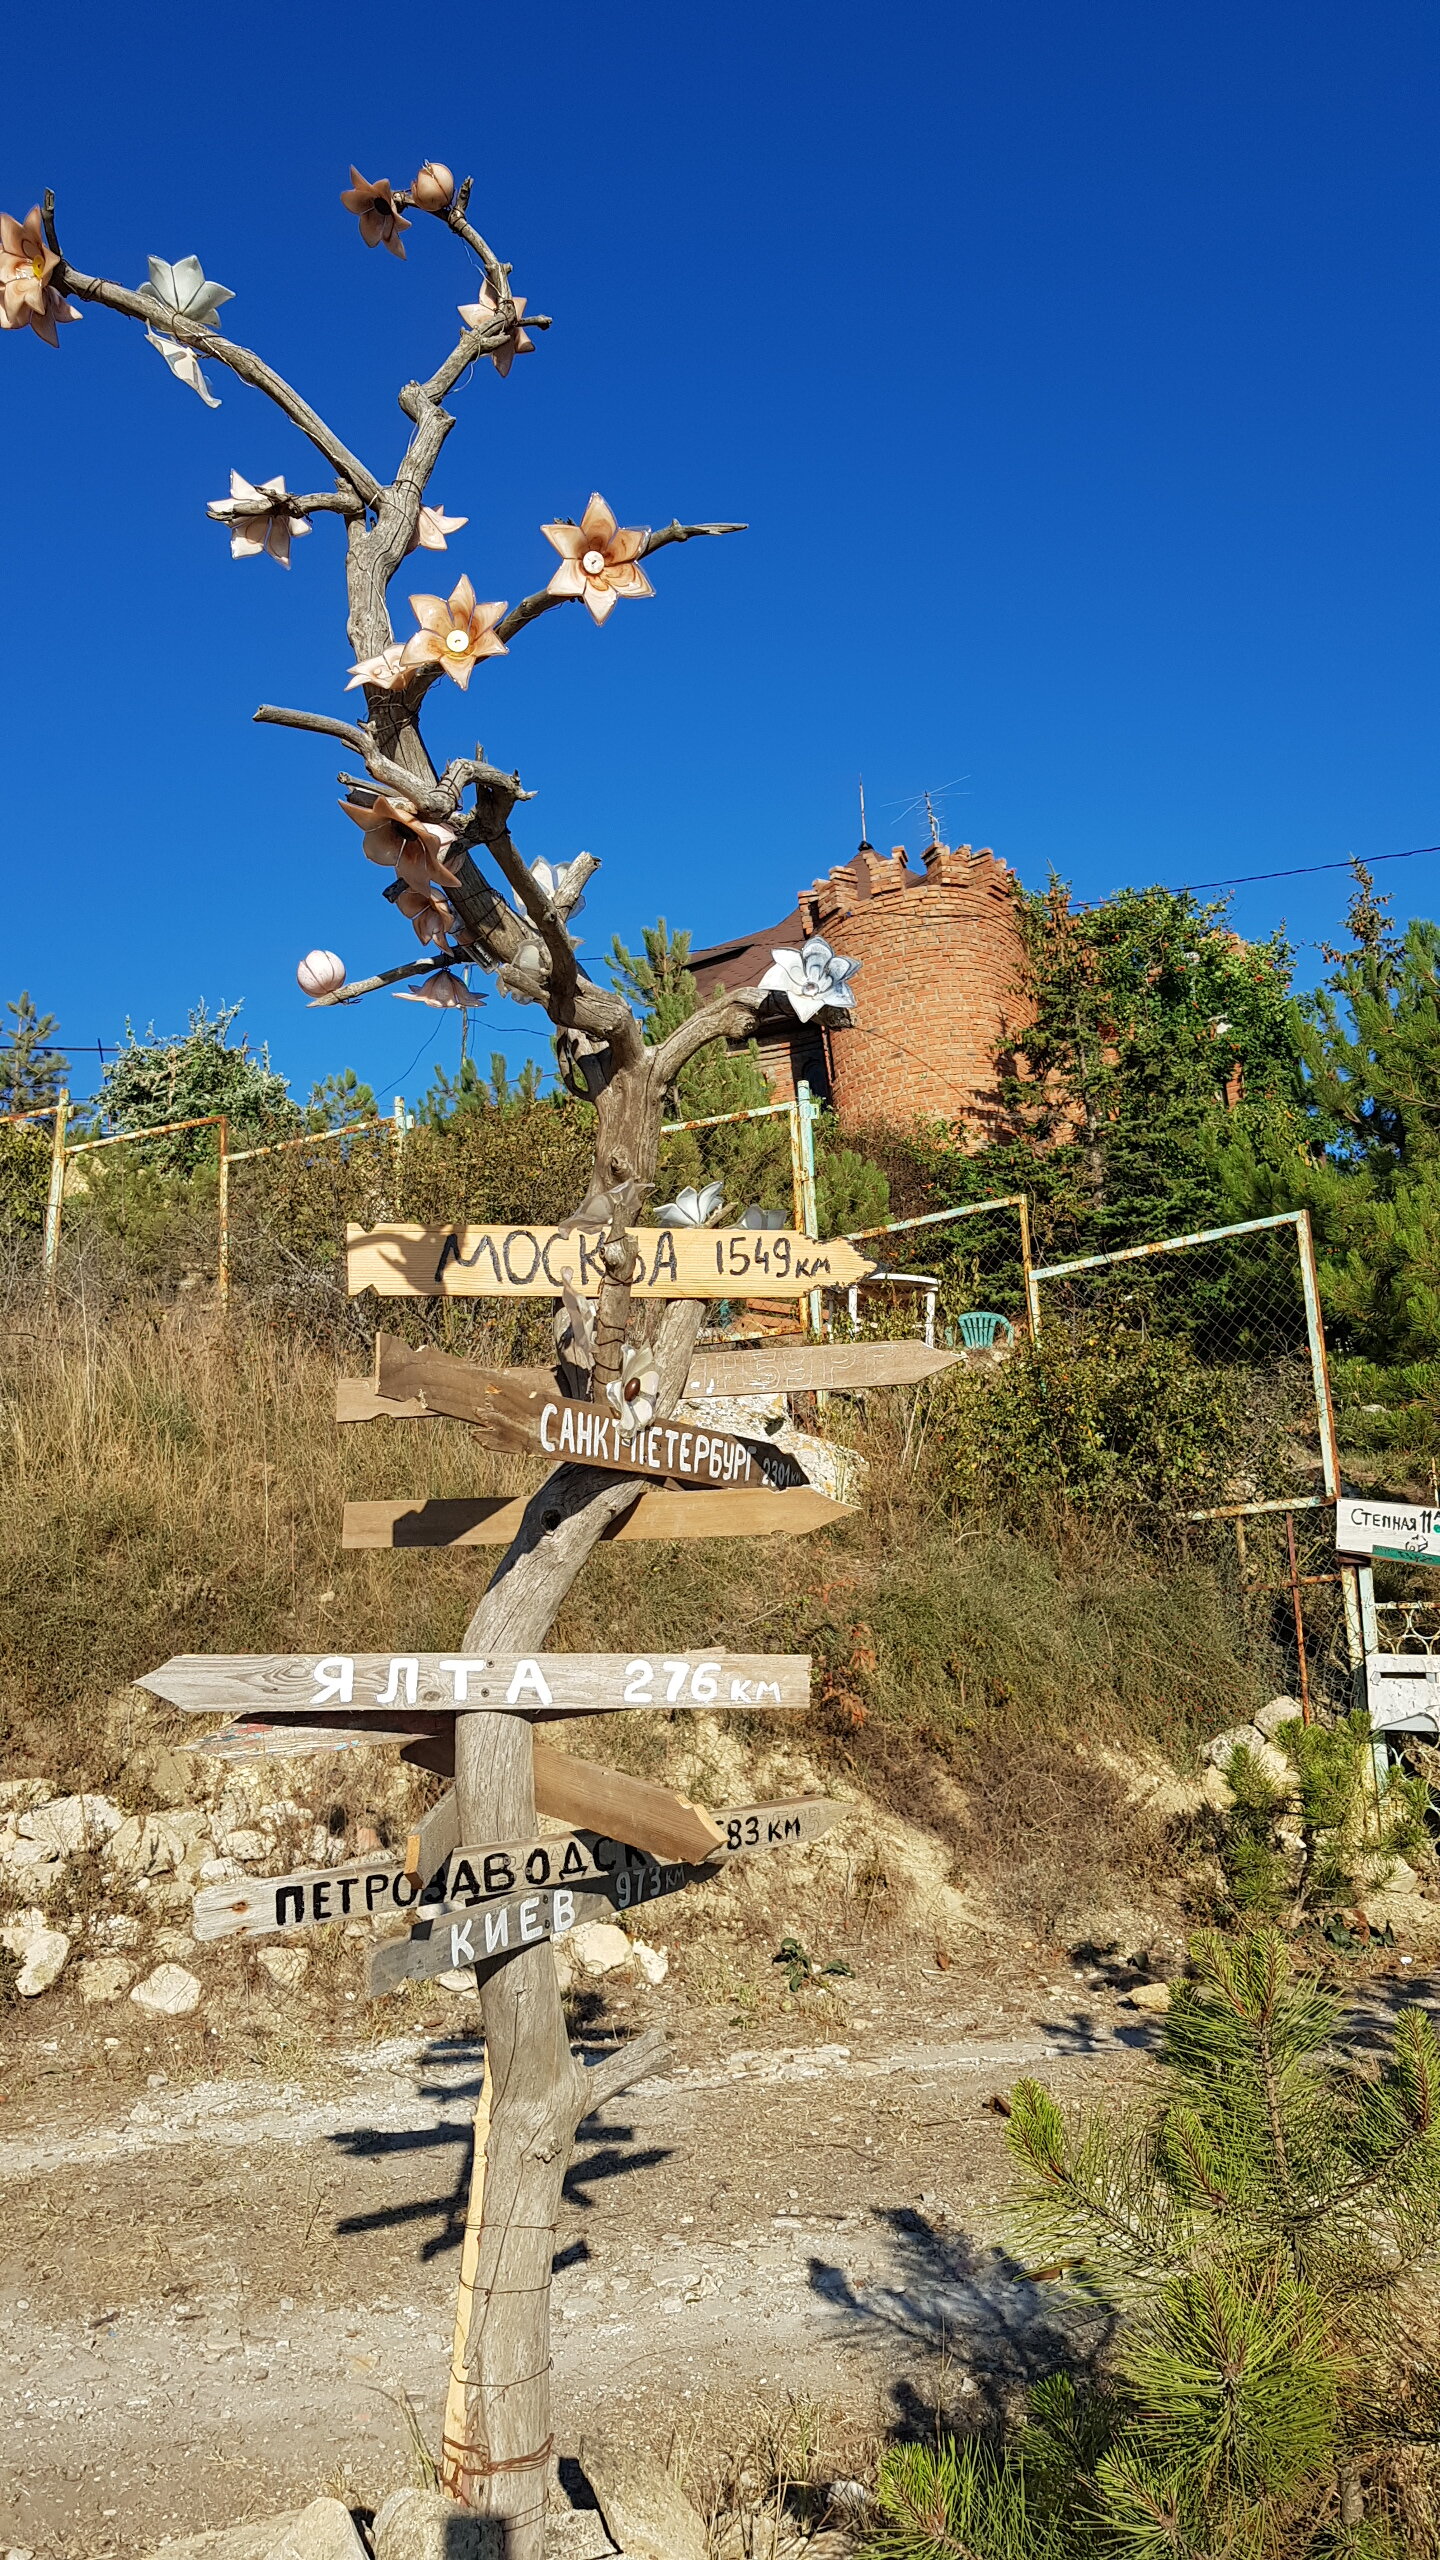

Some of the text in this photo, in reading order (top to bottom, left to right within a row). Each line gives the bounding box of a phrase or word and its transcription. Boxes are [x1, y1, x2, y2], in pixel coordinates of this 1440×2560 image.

[716, 1236, 791, 1278] 1549
[762, 1457, 791, 1487] 2301
[311, 1656, 553, 1705] ЯЛТА
[624, 1659, 722, 1704] 276
[451, 1889, 576, 1967] КИЕВ
[616, 1867, 661, 1908] 973
